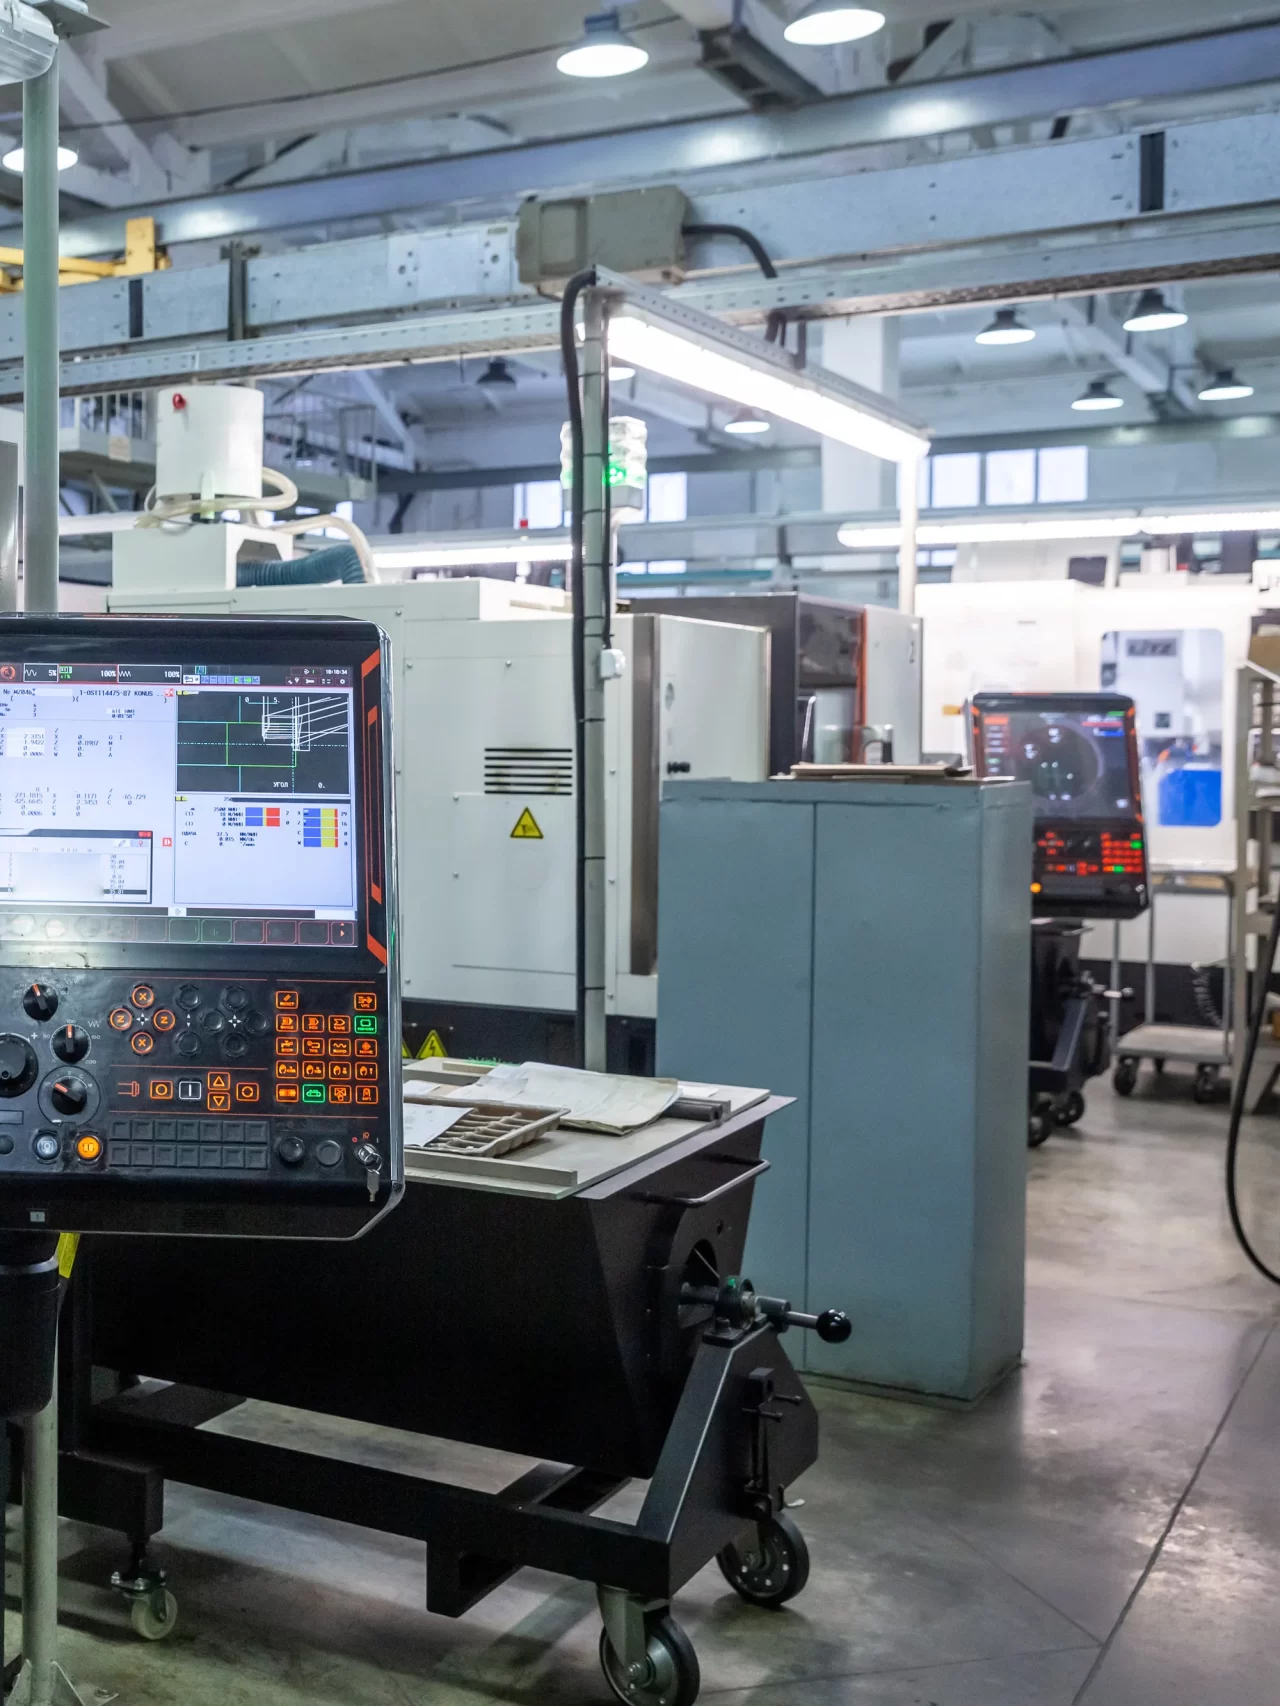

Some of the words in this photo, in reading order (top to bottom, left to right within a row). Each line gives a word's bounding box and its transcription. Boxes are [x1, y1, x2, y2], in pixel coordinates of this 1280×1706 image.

[140, 993, 146, 1001] X
[161, 1016, 168, 1024] Z
[138, 1039, 146, 1047] X
